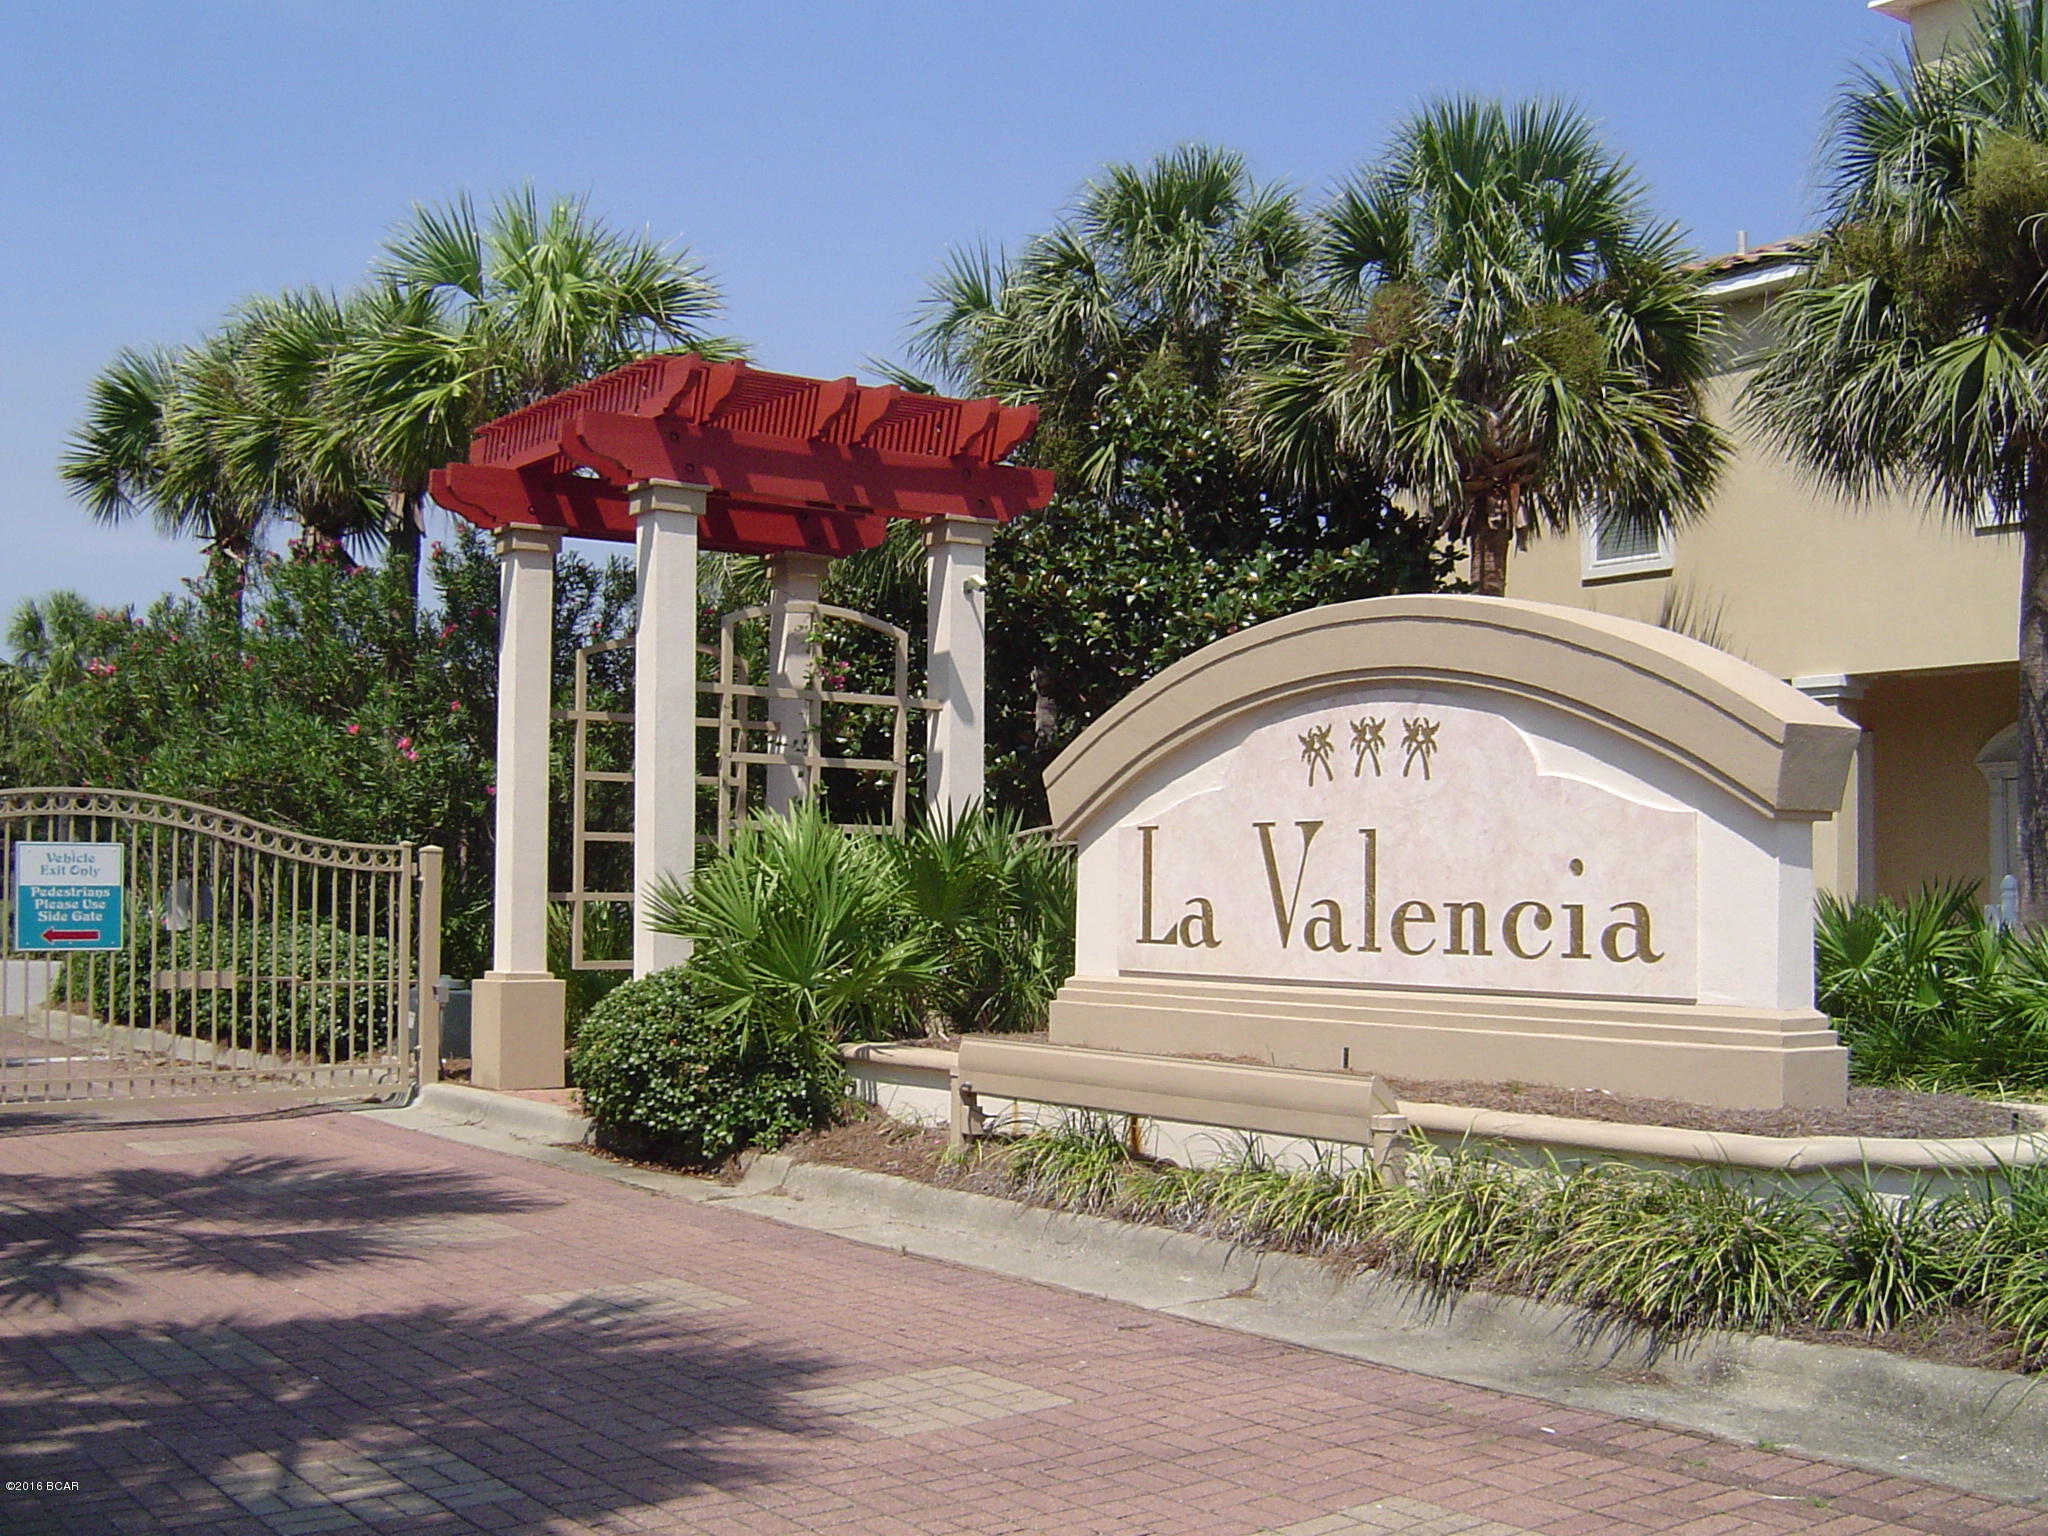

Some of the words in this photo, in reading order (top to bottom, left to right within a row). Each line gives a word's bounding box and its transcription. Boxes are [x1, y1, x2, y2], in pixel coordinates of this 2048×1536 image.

[46, 852, 96, 864] Vehicle
[40, 865, 66, 876] Exit
[69, 865, 101, 878] Only
[30, 887, 111, 899] Pedestrians
[1136, 825, 1223, 949] La
[1252, 820, 1666, 964] Valencia
[34, 899, 79, 910] Please
[82, 899, 107, 910] Use
[37, 911, 68, 922] Side
[71, 911, 104, 922] Gate
